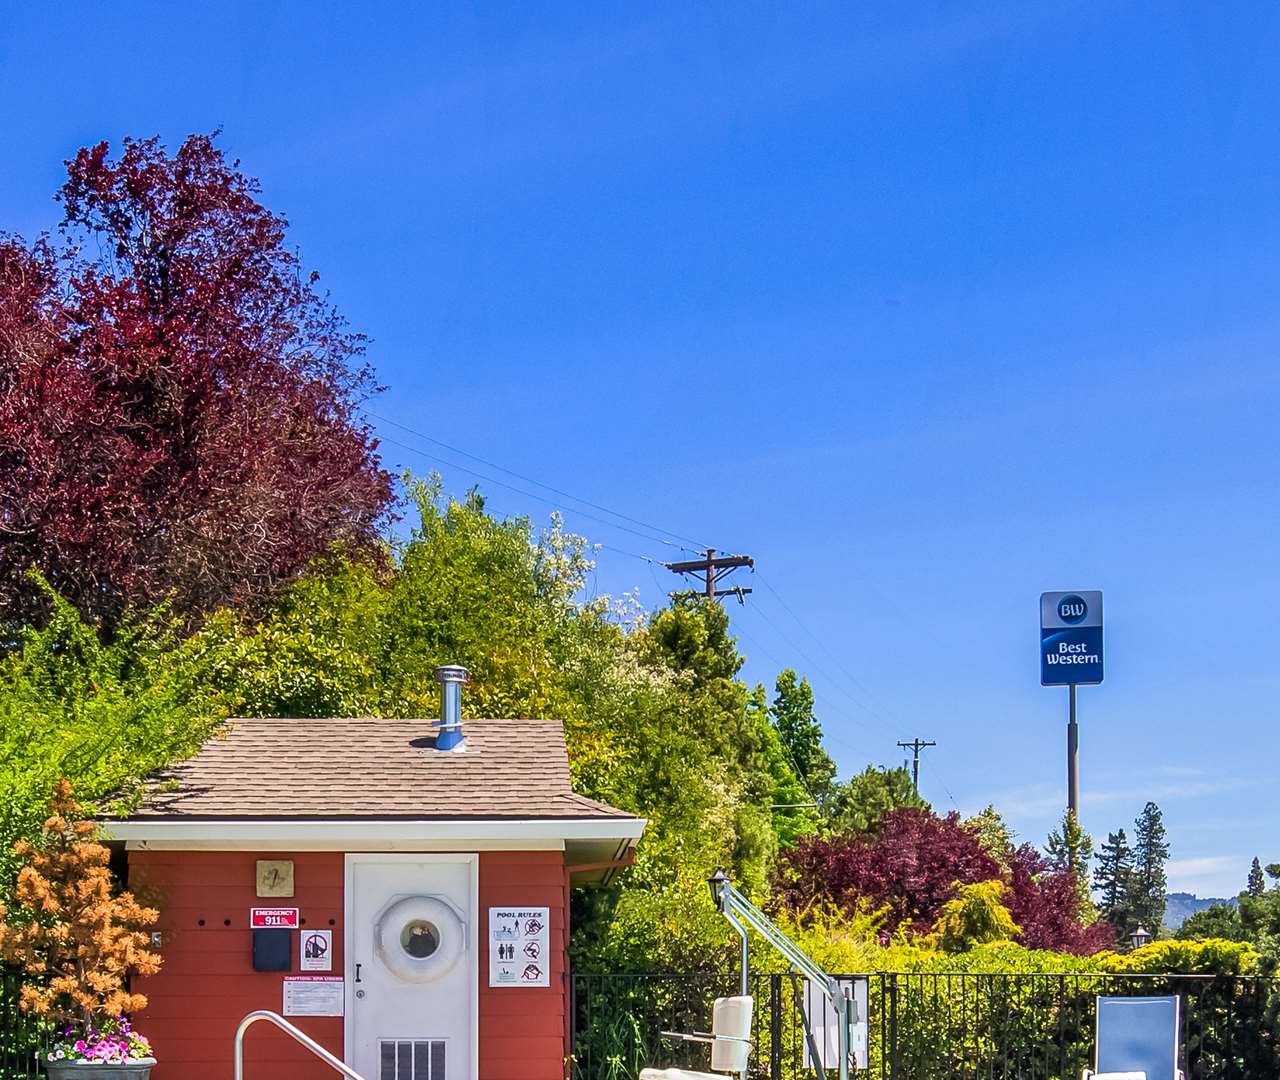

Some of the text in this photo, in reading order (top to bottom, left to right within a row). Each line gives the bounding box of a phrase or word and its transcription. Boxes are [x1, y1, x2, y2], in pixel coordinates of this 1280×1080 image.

[1061, 604, 1084, 616] BW
[1059, 642, 1087, 653] Best
[1047, 654, 1098, 664] Western
[265, 916, 281, 925] 911
